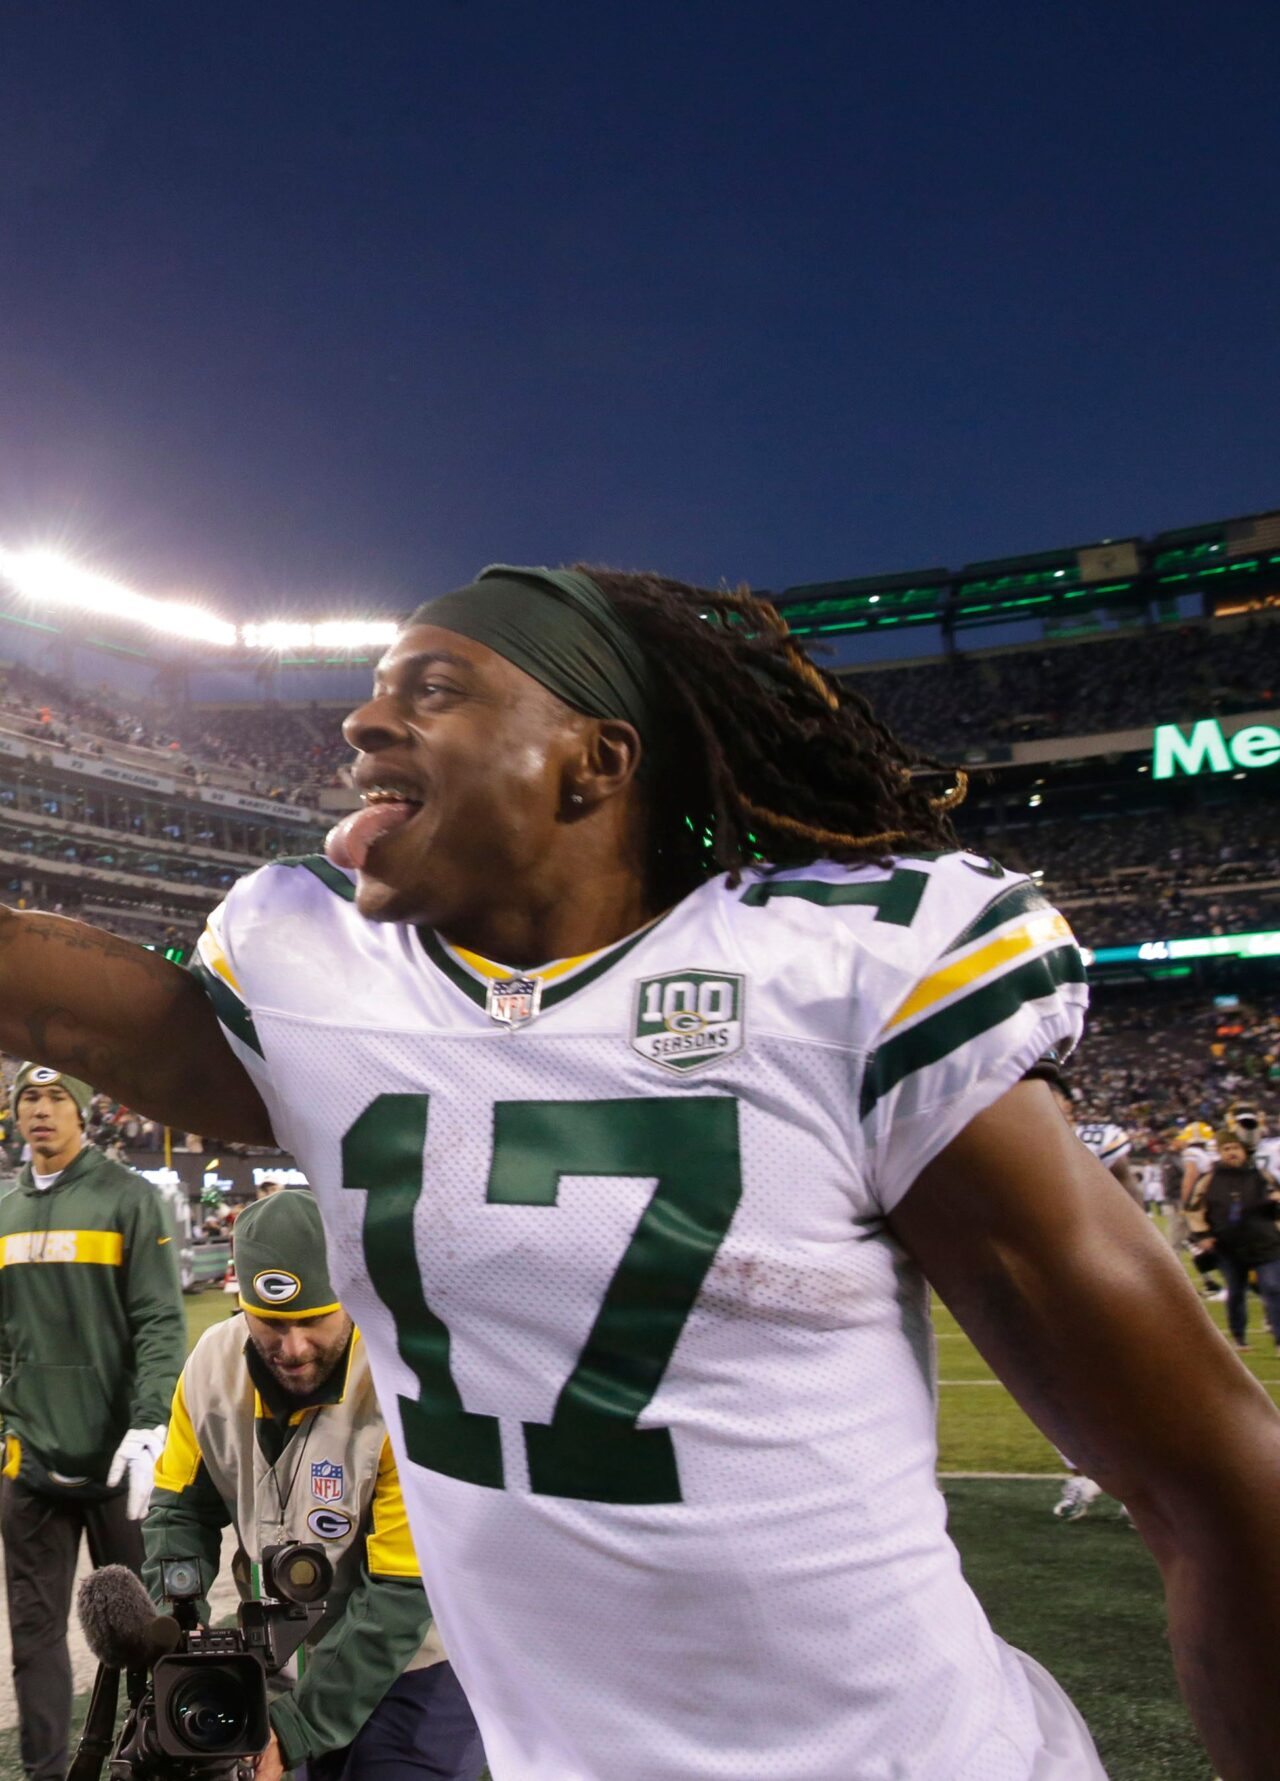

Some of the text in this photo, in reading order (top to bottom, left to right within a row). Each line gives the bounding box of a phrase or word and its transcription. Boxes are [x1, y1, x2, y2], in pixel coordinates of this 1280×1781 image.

[642, 981, 734, 1023] 100
[651, 1028, 730, 1058] SEASONS
[342, 1092, 742, 1505] 17
[313, 1477, 341, 1499] NFL
